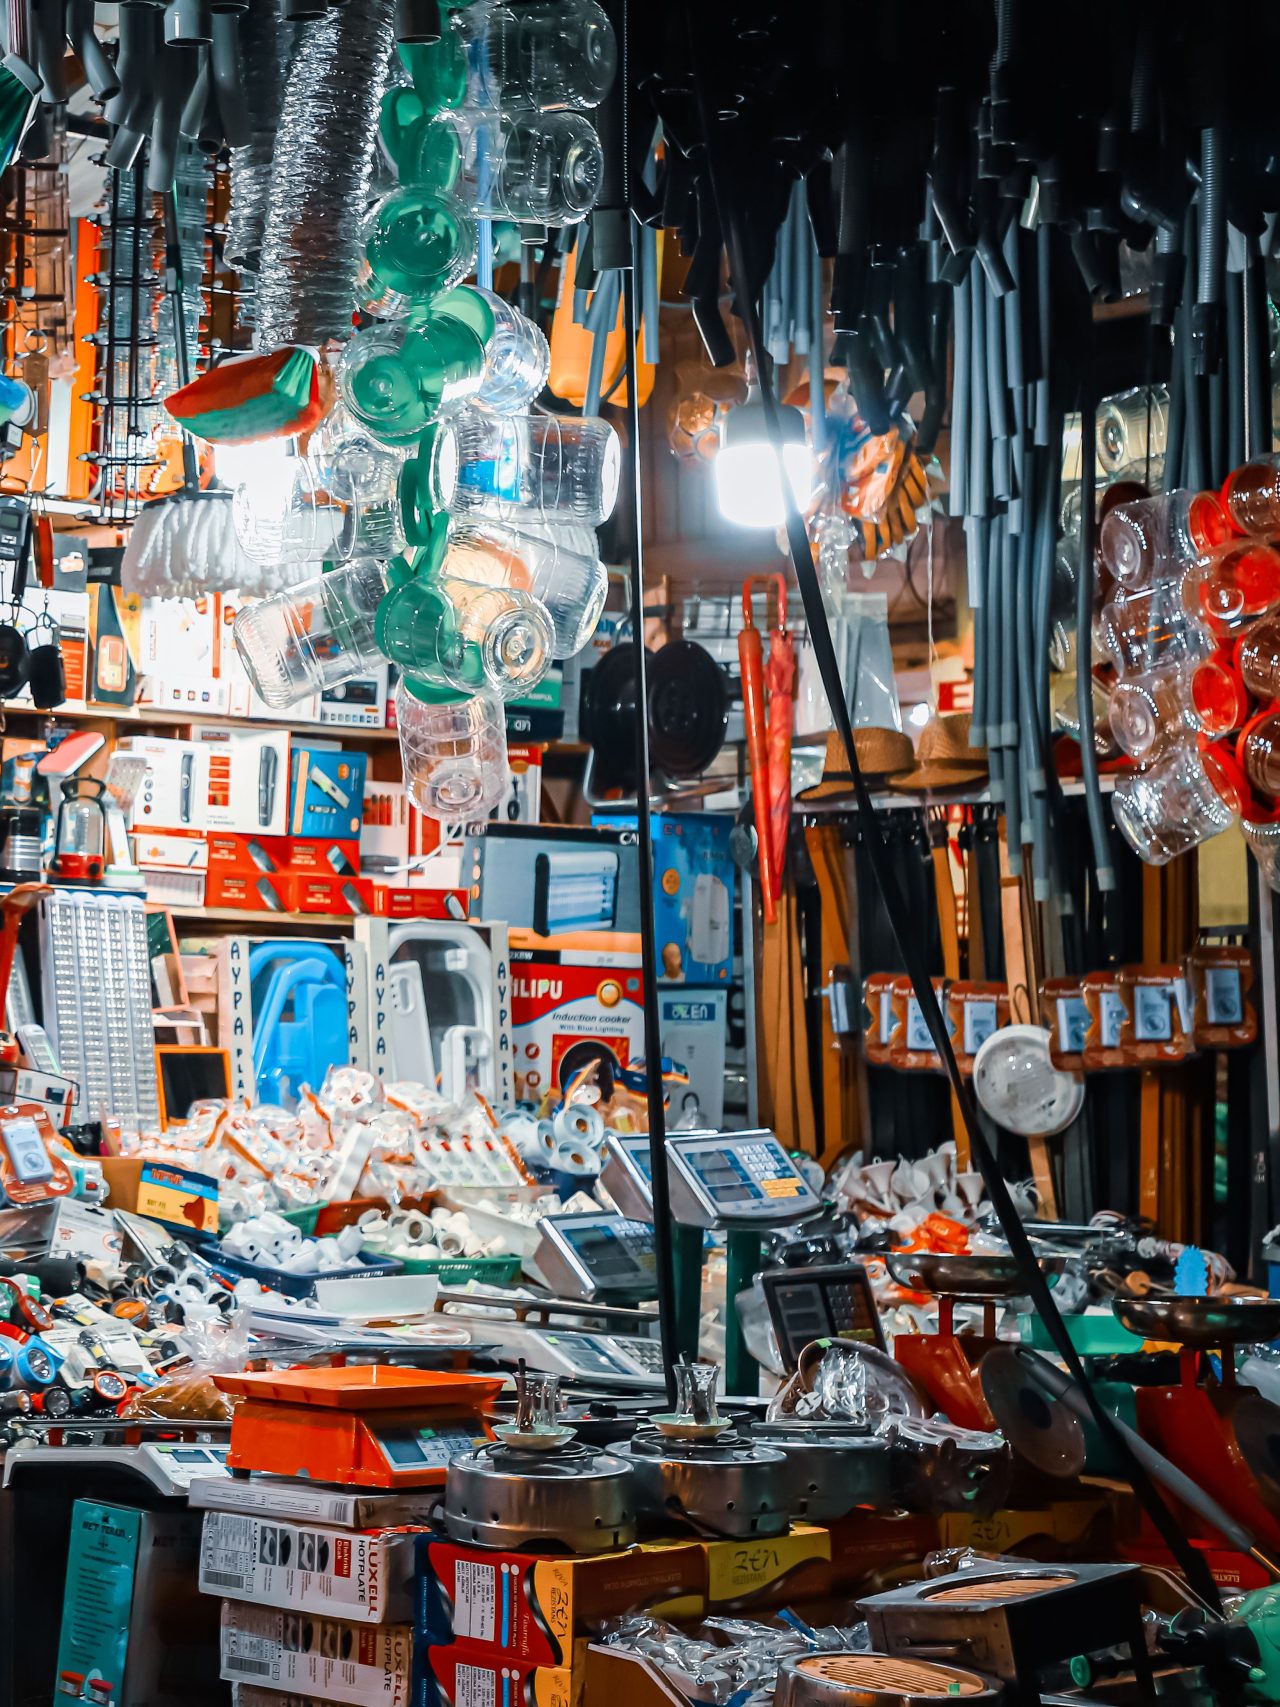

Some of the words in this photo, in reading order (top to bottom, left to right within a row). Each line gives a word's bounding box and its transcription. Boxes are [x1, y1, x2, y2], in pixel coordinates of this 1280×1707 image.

[552, 1012, 597, 1022] Induction
[599, 1015, 632, 1024] cooker
[595, 1026, 624, 1034] Lighting
[335, 1540, 343, 1560] Ocak
[342, 1541, 350, 1577] Elektrikli
[357, 1539, 366, 1603] HOTPLATE
[367, 1540, 379, 1617] LUXELL
[384, 1629, 393, 1692] HOTPLATE
